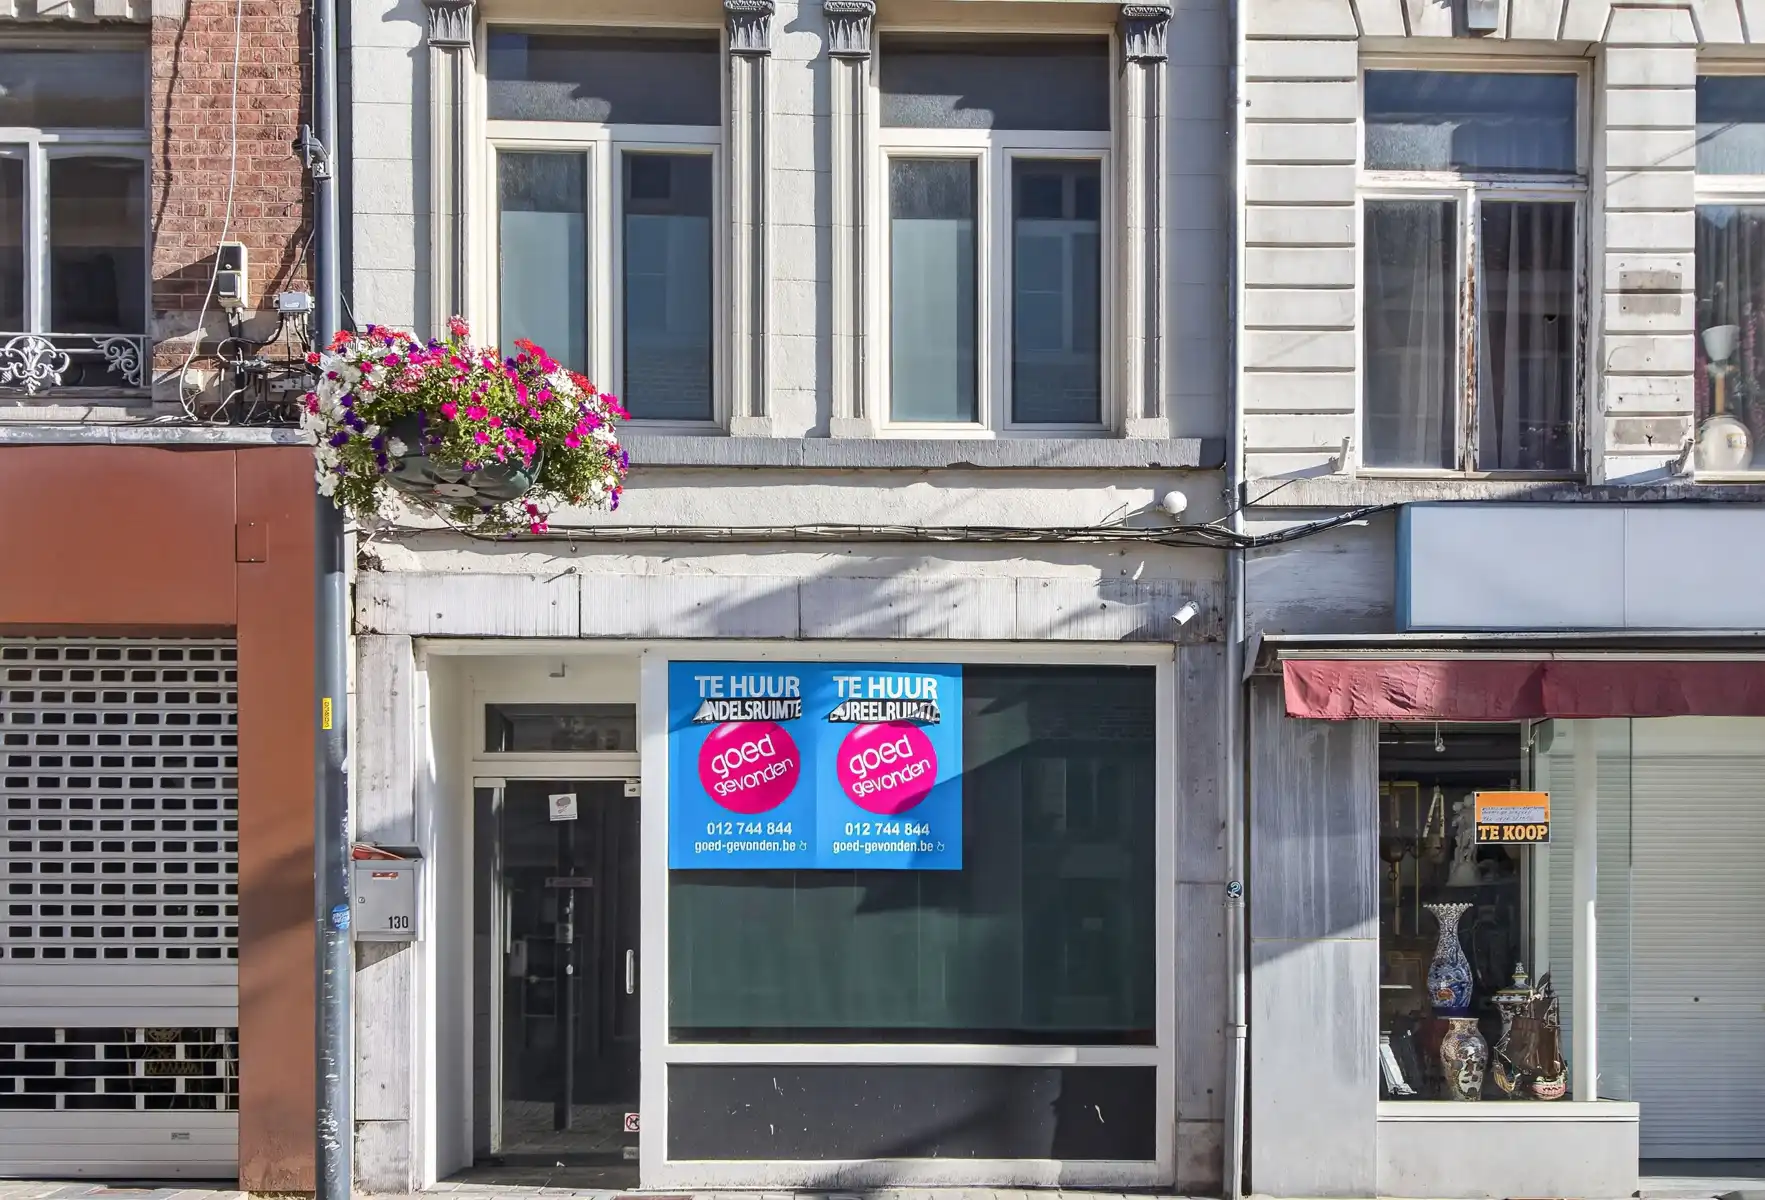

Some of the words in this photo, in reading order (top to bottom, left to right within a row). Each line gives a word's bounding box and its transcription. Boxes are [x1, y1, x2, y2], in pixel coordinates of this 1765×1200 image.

[694, 675, 724, 698] TE
[730, 675, 800, 698] HUUR
[832, 675, 862, 698] TE
[868, 676, 938, 699] HUUR
[711, 733, 776, 779] goed
[849, 734, 914, 779] goed
[713, 758, 793, 797] gevonden
[851, 759, 931, 797] gevonden
[706, 821, 733, 836] 012
[736, 821, 762, 836] 744
[766, 821, 793, 836] 844
[845, 822, 871, 836] 012
[875, 822, 900, 836] 744
[904, 822, 930, 836] 844
[1478, 825, 1499, 840] TE
[1502, 825, 1548, 840] KOOP
[694, 839, 796, 854] goed-gevonden.be
[833, 840, 934, 854] goed-gevonden.be
[388, 915, 409, 929] 130
